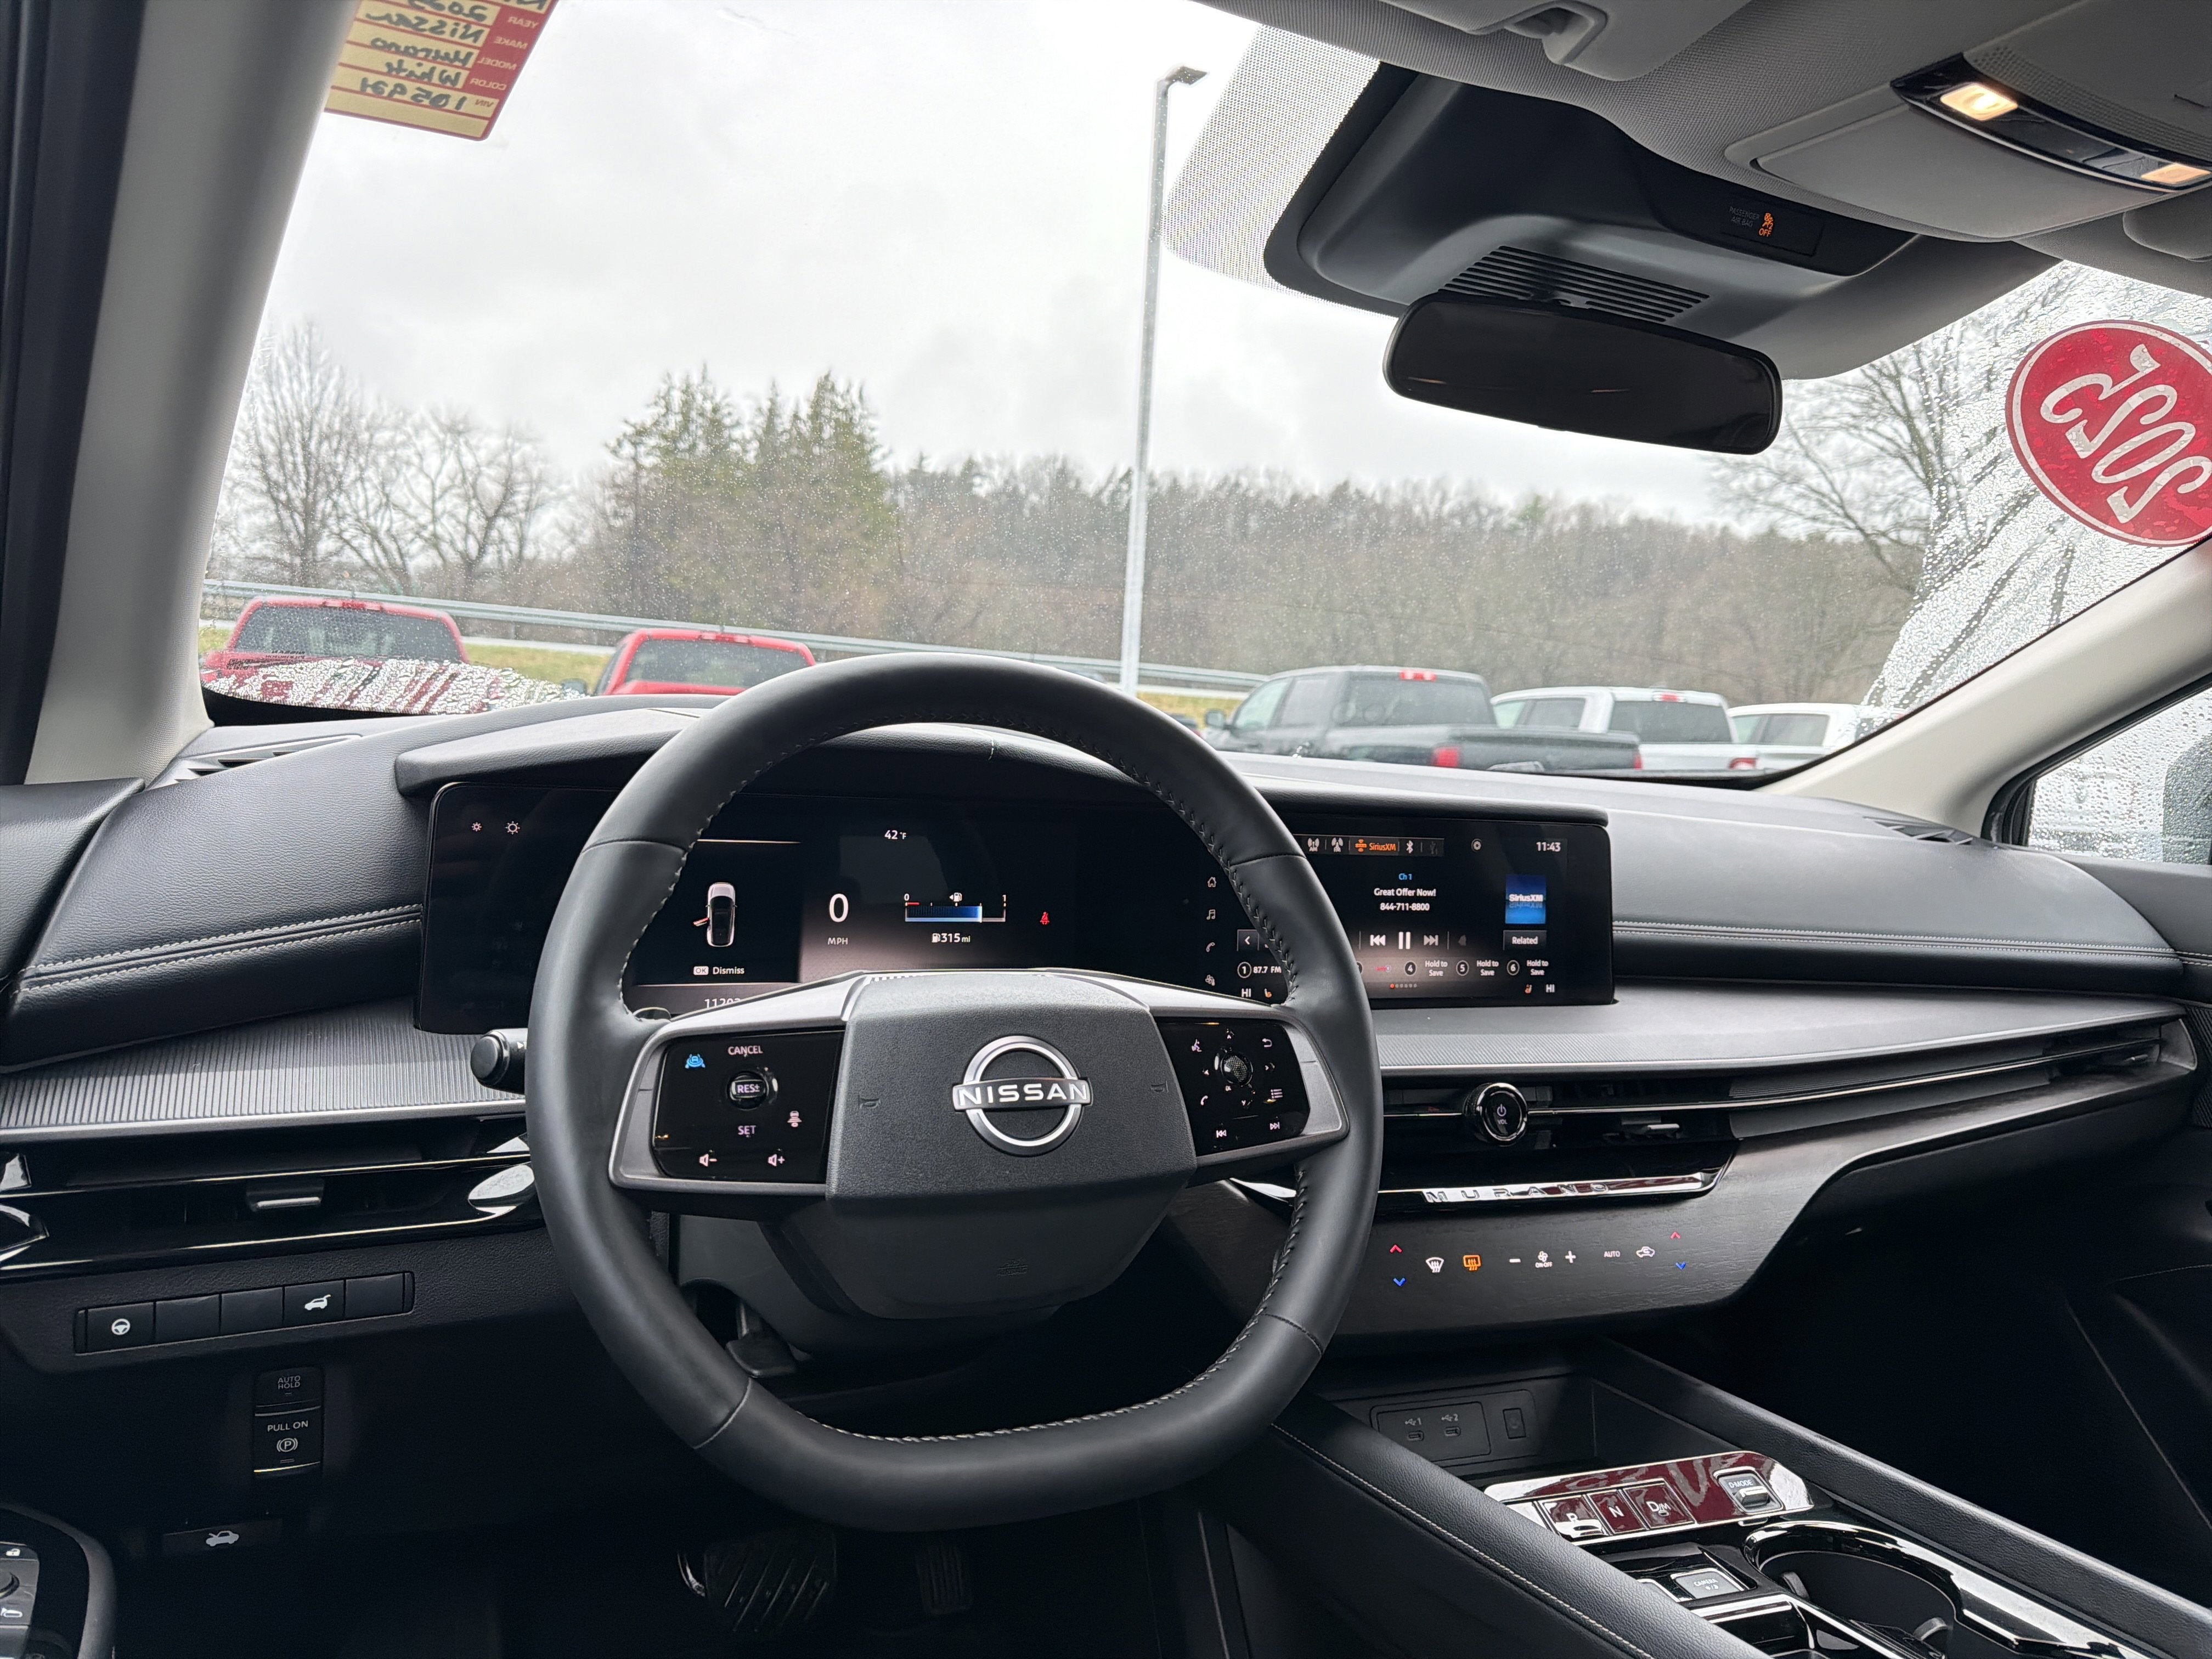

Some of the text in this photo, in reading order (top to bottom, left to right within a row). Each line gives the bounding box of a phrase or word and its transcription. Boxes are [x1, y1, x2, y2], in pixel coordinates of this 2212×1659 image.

[1729, 206, 1759, 220] PASSENGER
[1741, 219, 1753, 227] BAG
[1758, 228, 1772, 237] OFF
[1369, 842, 1396, 851] SiriusXM
[1536, 842, 1561, 852] 11:43
[1374, 888, 1436, 896] Great Offer Now!
[1509, 894, 1543, 902] SiriusXM
[829, 893, 849, 922] 0
[827, 937, 848, 945] MPH
[1242, 988, 1251, 997] HI
[1545, 984, 1555, 993] HI
[727, 1045, 763, 1055] CANCEL
[958, 1083, 1087, 1107] NISSAN
[738, 1126, 757, 1135] SET
[1426, 1182, 1610, 1203] MURANO
[278, 1375, 301, 1384] AUTO
[278, 1381, 301, 1390] HOLD
[1453, 1413, 1459, 1421] 2
[267, 1420, 308, 1432] PULL ON
[1608, 1505, 1624, 1518] N
[1693, 1577, 1718, 1587] CAMERA
